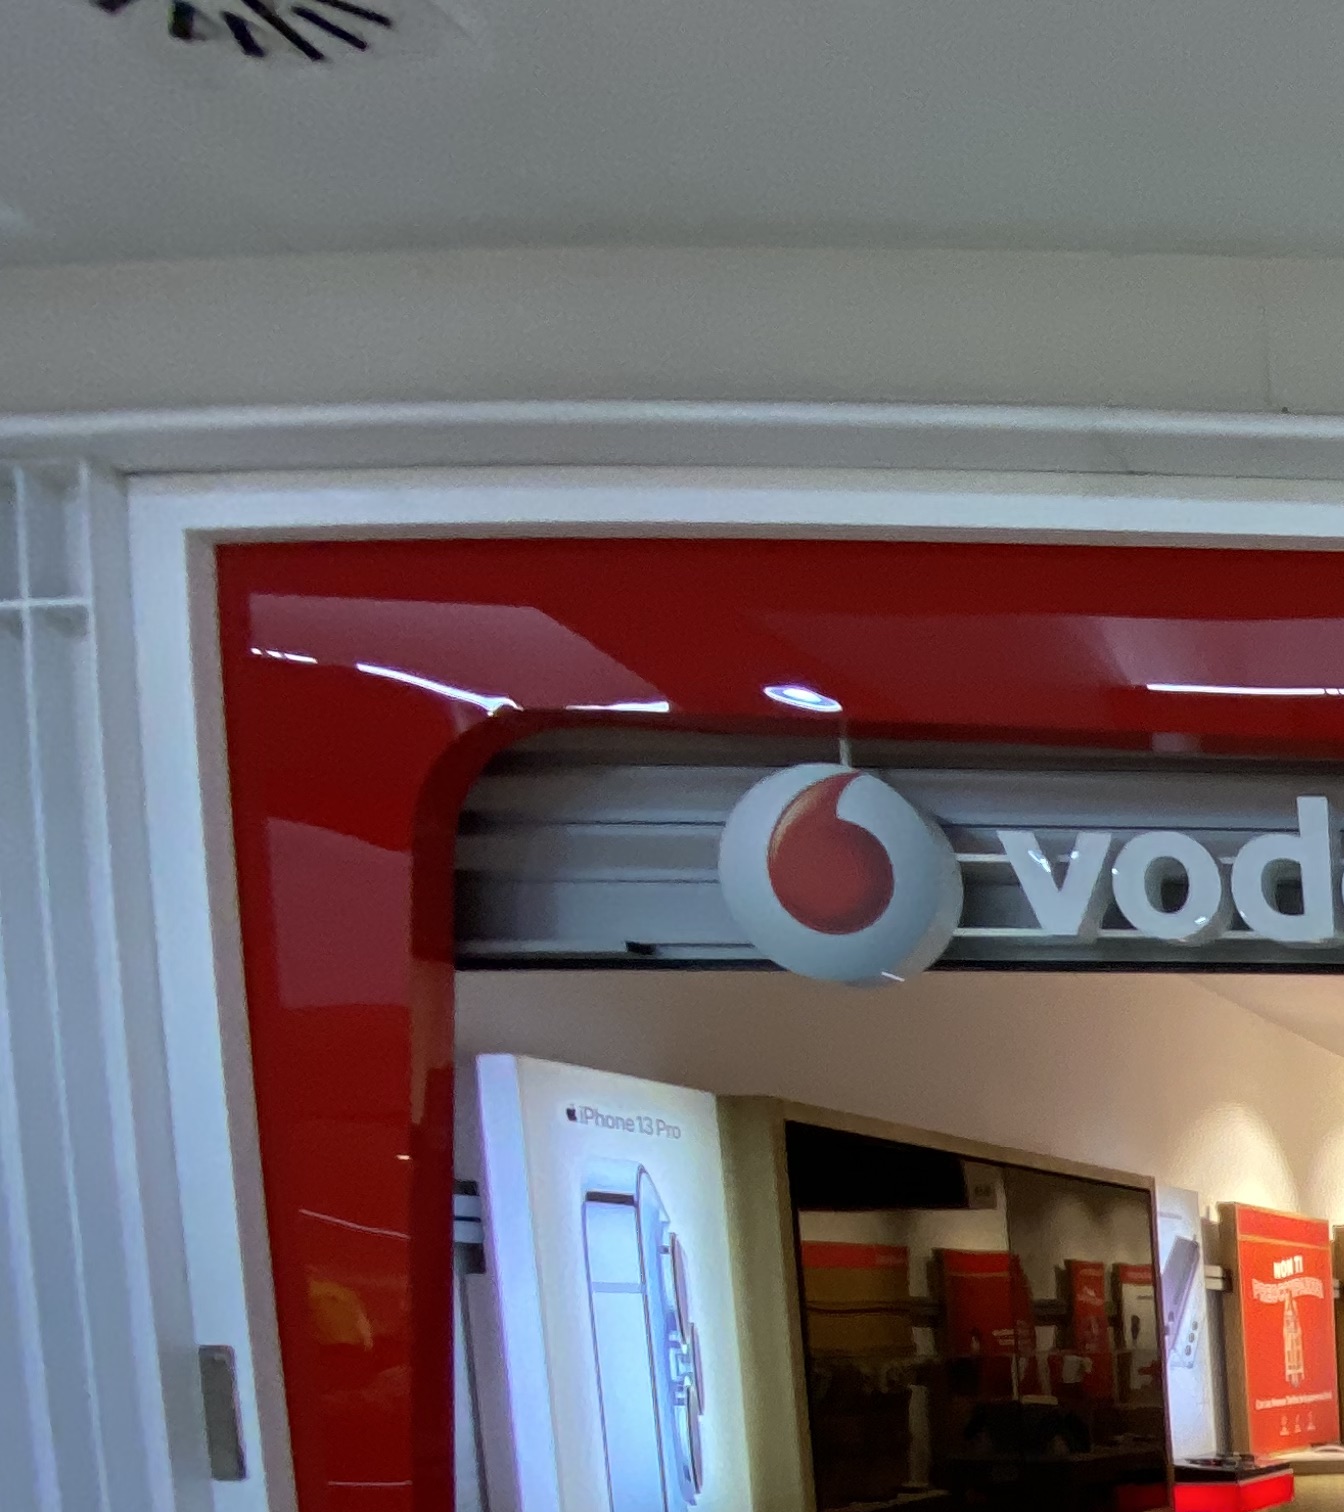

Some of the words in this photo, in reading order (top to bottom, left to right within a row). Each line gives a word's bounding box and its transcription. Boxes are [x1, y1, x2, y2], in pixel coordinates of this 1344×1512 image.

[579, 1105, 635, 1133] iPhone
[635, 1115, 654, 1136] 13
[656, 1118, 681, 1140] Pro
